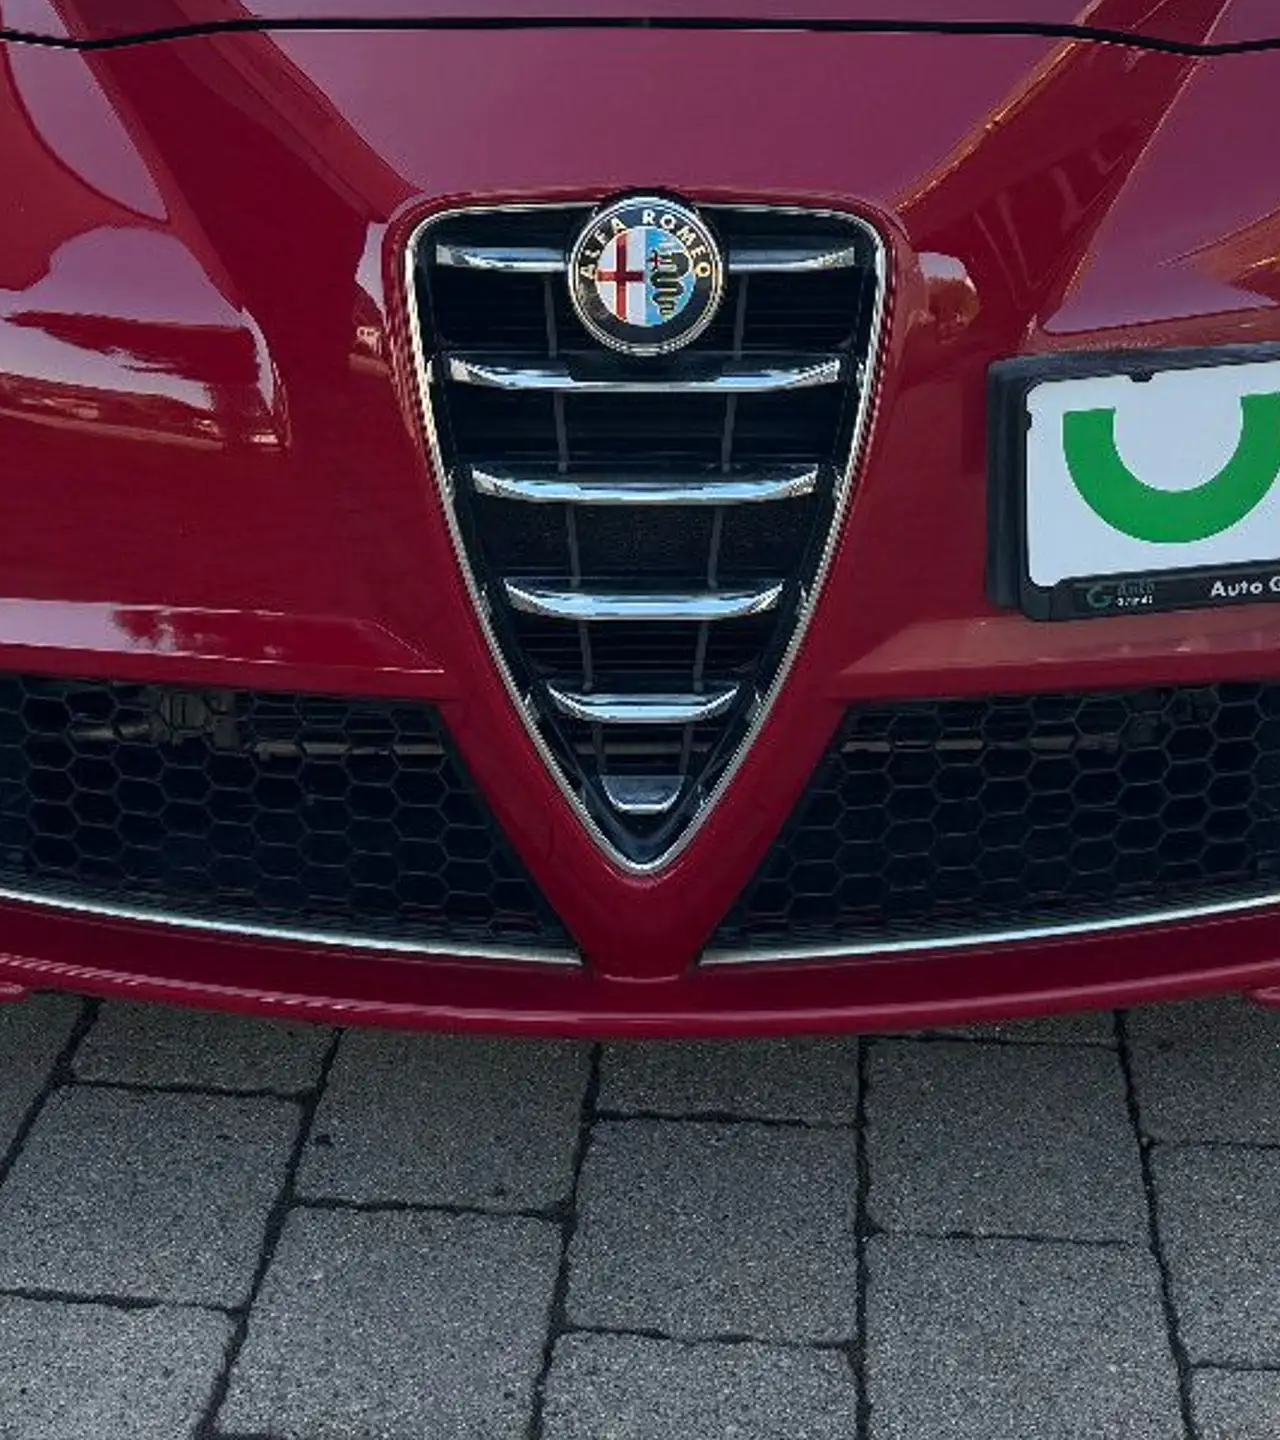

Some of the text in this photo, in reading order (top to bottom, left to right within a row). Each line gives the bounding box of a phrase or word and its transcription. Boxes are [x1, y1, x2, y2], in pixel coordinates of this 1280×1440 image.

[580, 210, 711, 280] ALFA ROMEO
[1210, 577, 1263, 598] Auto
